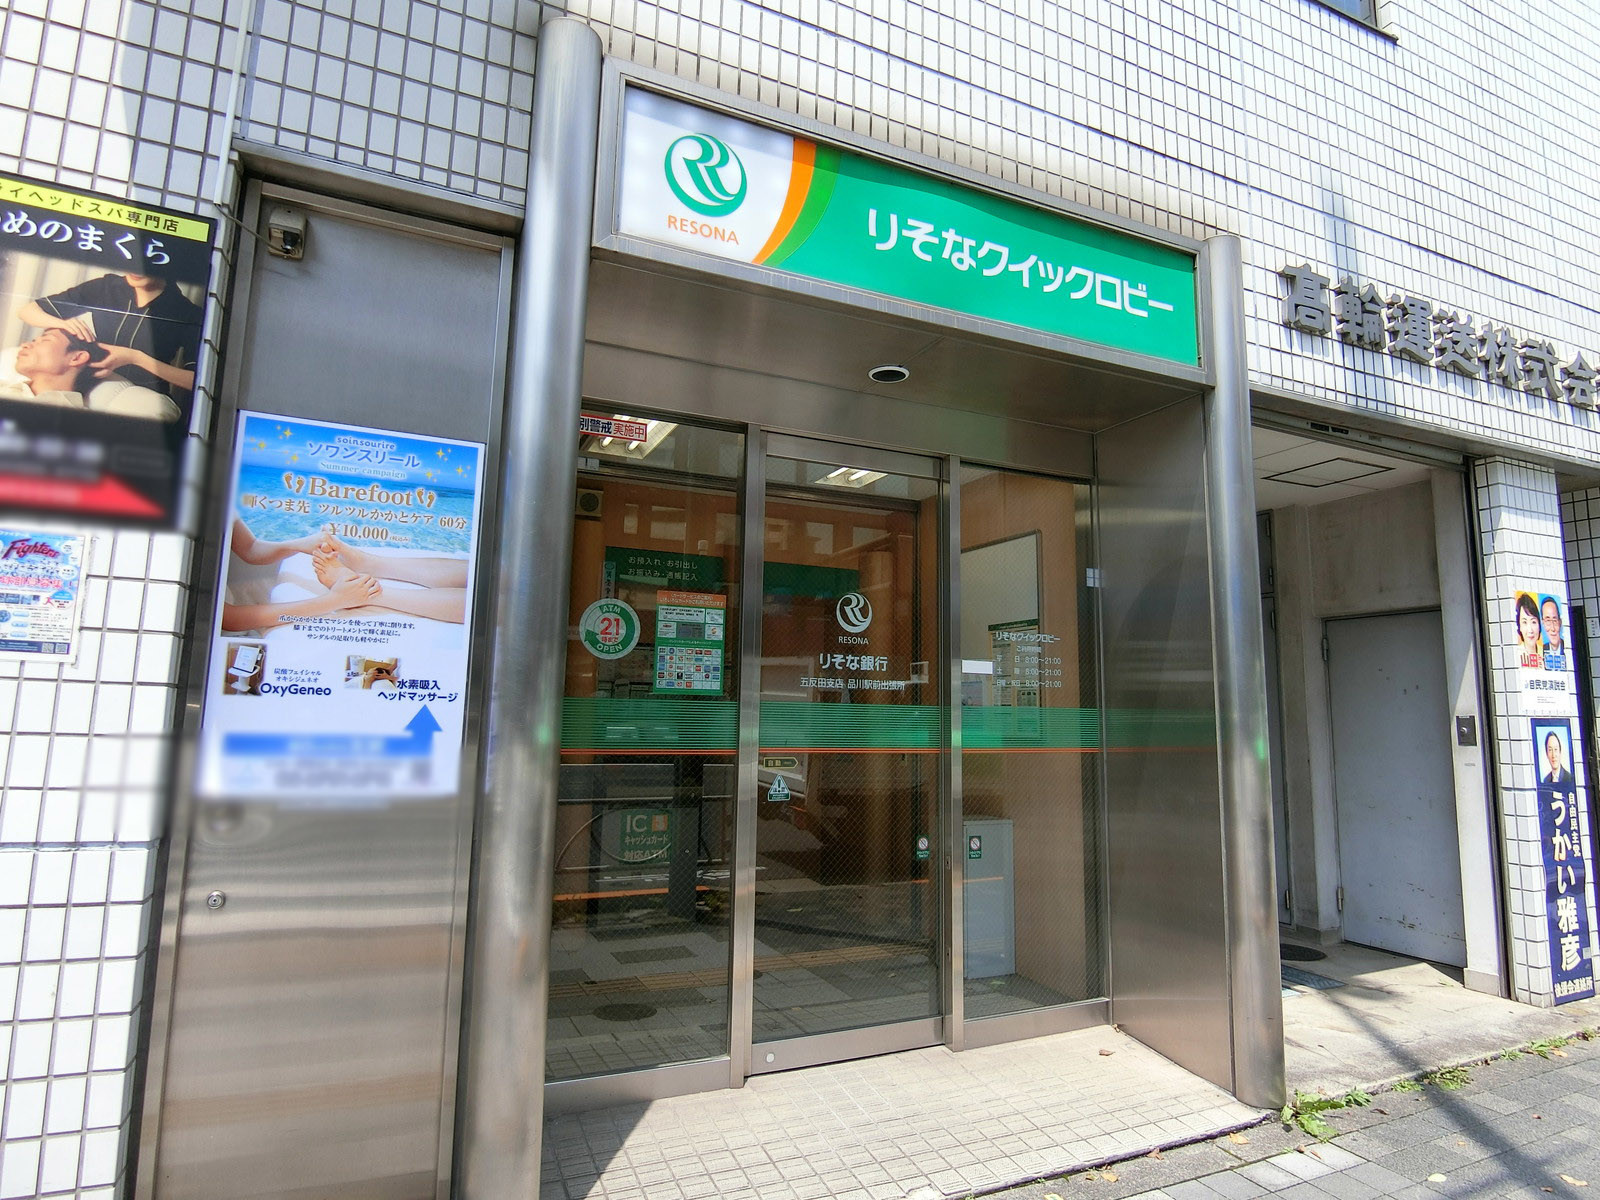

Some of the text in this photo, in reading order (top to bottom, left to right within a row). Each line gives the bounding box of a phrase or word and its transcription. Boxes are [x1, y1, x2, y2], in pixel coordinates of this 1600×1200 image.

[0, 183, 179, 232] イヘッドスパ専門店
[0, 210, 170, 265] めのまくら
[667, 214, 739, 245] RESONA
[868, 208, 1174, 318] りそなクイックロビー
[337, 436, 396, 450] soinsourire
[307, 442, 420, 468] ソワンスリール
[320, 462, 406, 479] Summer campaign
[309, 477, 412, 506] Barefoot
[318, 503, 434, 526] ツルツルかかとケア
[439, 516, 467, 530] 60分
[1, 538, 60, 559] Fighters
[602, 605, 621, 614] ATM
[600, 617, 620, 636] 21
[838, 636, 869, 645] RESONA
[996, 631, 1061, 643] りそなクイックロビー
[596, 644, 622, 654] OPEN
[819, 653, 888, 672] りそな銀行
[260, 683, 332, 697] OxyGeneo
[397, 679, 440, 691] 水素吸入
[800, 677, 844, 689] 五反田支店
[378, 690, 458, 702] ヘッドマッサージ
[626, 815, 647, 832] IC
[1550, 791, 1582, 971] うかい雅彦
